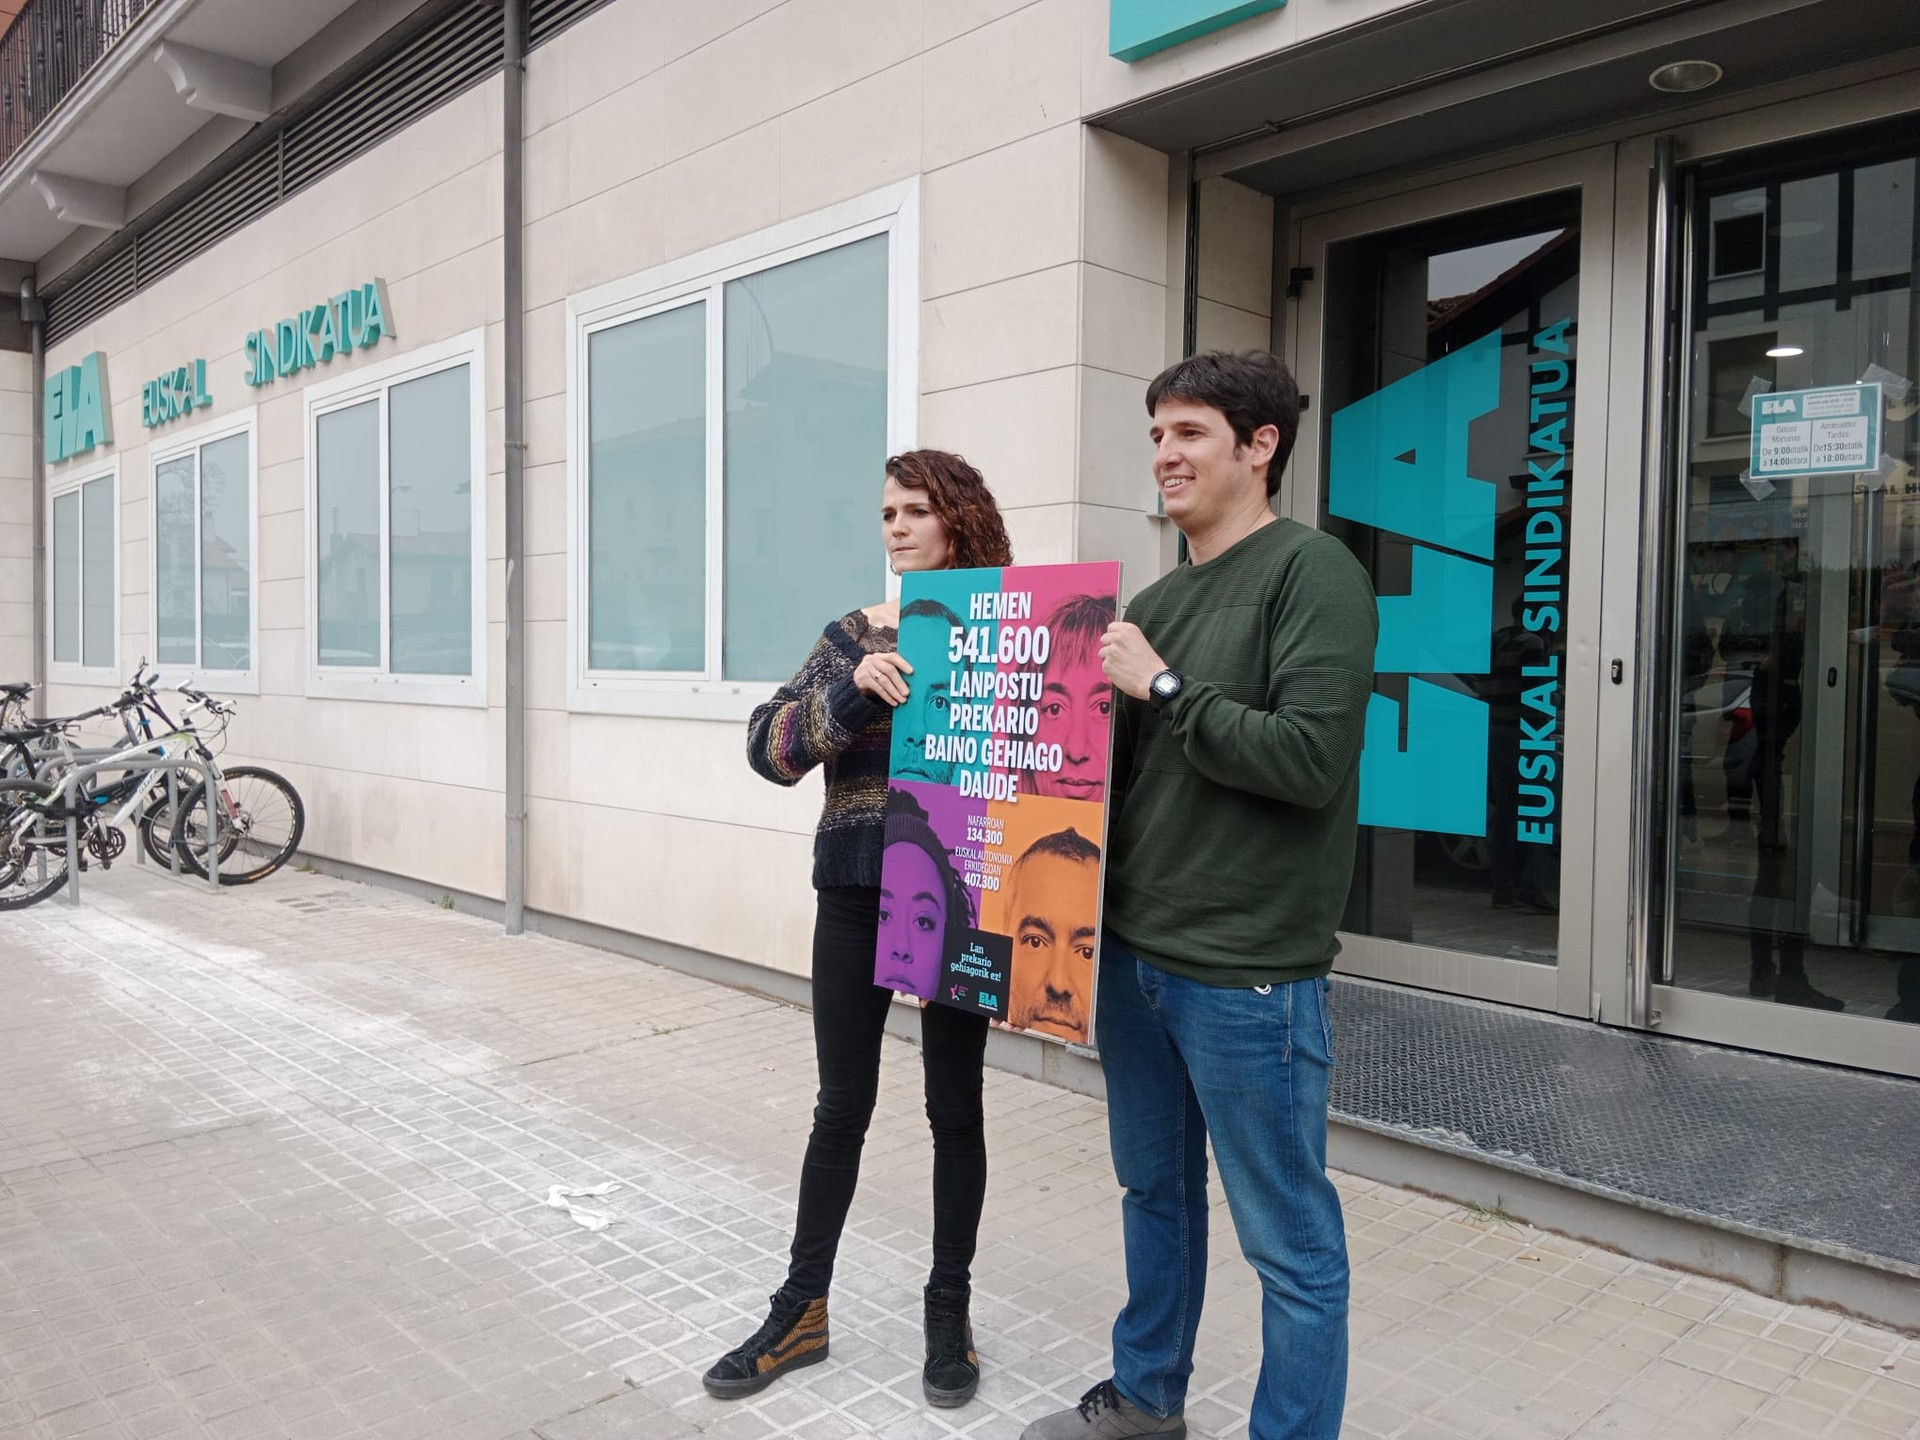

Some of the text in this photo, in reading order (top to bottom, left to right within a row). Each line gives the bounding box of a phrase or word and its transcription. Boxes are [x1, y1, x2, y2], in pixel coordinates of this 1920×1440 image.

[44, 277, 396, 464] ELA EUSKAL SINDIKATUA
[1761, 399, 1796, 415] ELA
[1328, 327, 1503, 837] ELA
[1517, 316, 1571, 845] EUSKAL SINDIKATUA
[969, 591, 1032, 620] HEMEN
[948, 625, 1050, 665] 541.600
[949, 670, 1043, 701] LANPOSTU
[949, 703, 1039, 735] PREKARIO
[924, 734, 1063, 772] BAINO GEHIAGO
[959, 770, 1019, 803] DAUDE
[967, 815, 1004, 830] NAFARROAN
[967, 827, 1003, 845] 134.300
[955, 846, 1013, 866] EUSKAL AUTONOMIA
[964, 860, 1002, 876] ERKIDEGOAN
[964, 872, 1000, 891] 407.300
[970, 942, 984, 954] Lan
[961, 953, 992, 968] prekario
[950, 962, 1001, 982] gehiagorik ez!
[979, 991, 998, 1008] ELA
